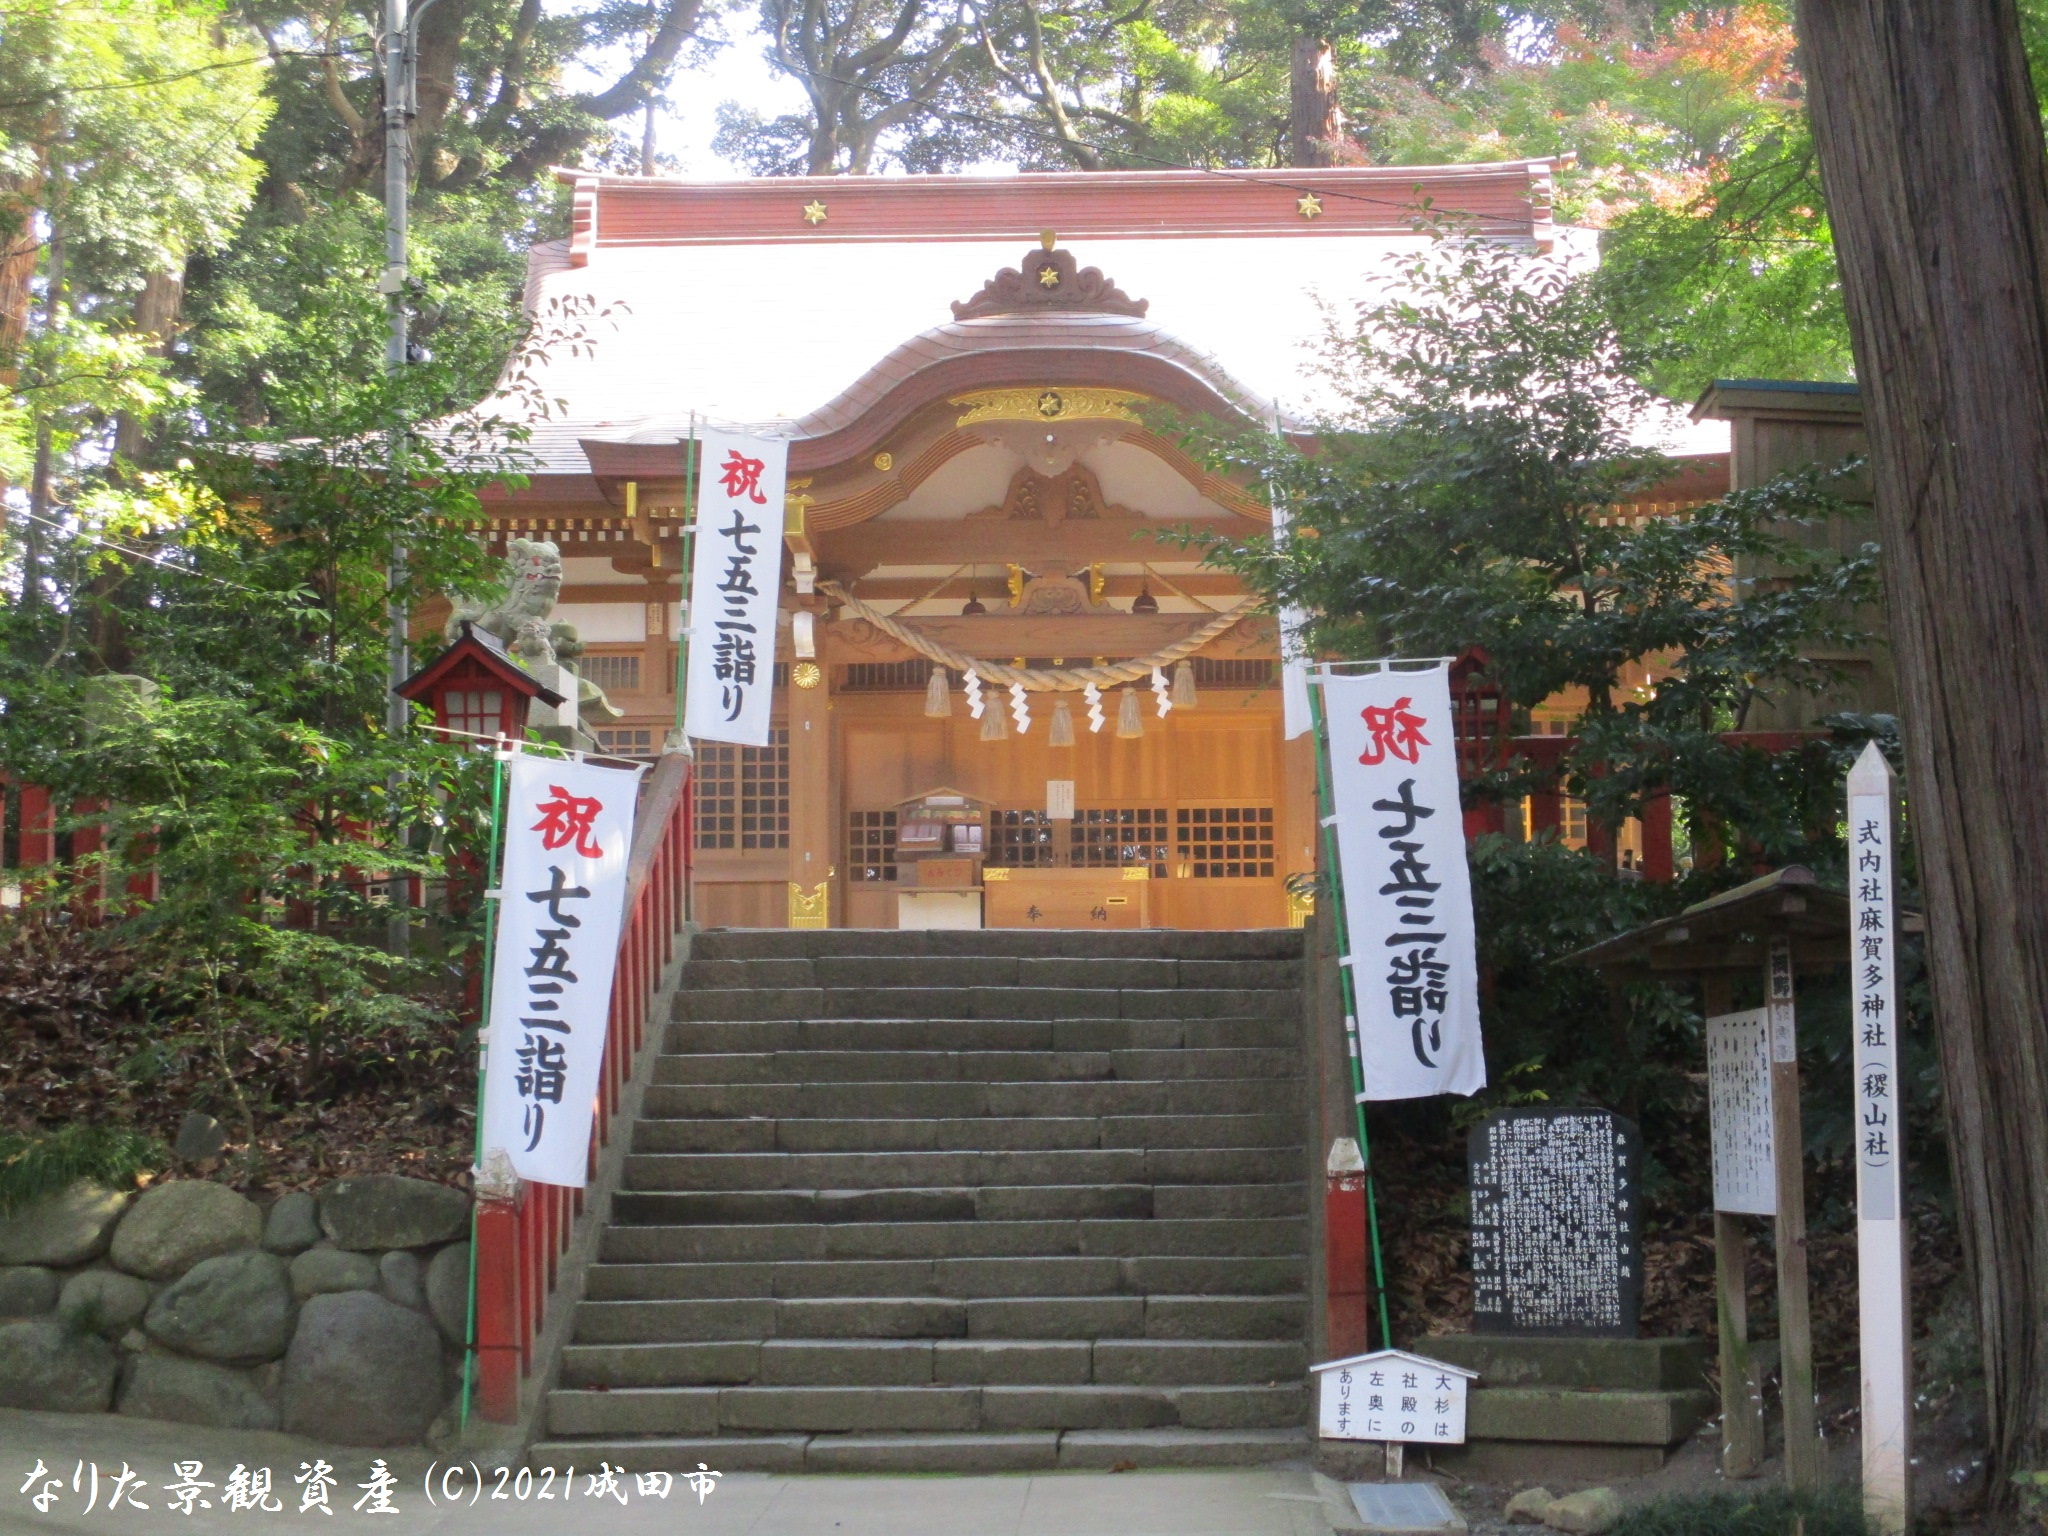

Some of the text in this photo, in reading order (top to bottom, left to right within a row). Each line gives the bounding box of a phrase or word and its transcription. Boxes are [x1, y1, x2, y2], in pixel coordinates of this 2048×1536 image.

[1616, 1133, 1631, 1277] 麻賀多神社由緒
[1368, 1371, 1385, 1432] 左奥に
[1401, 1372, 1418, 1435] 社殿の
[1434, 1373, 1452, 1437] 大杉は
